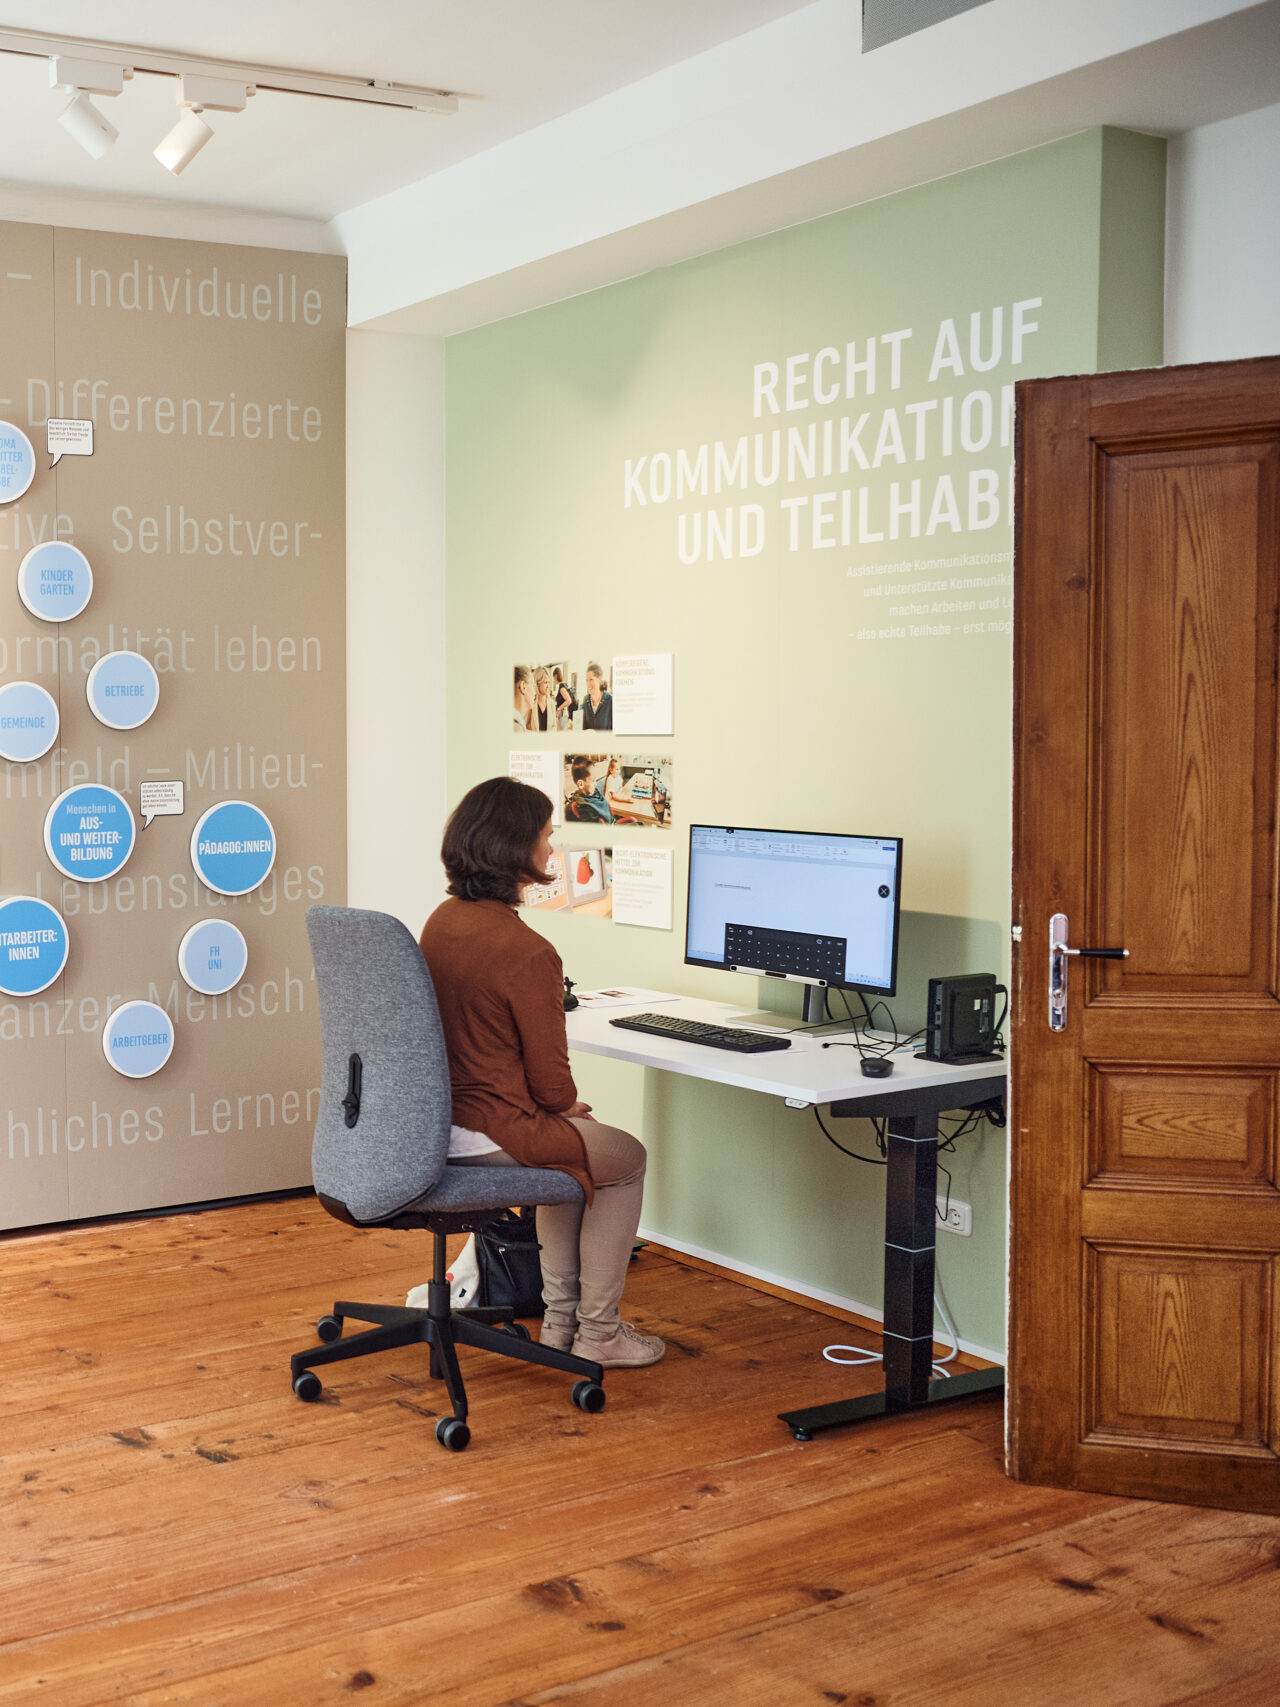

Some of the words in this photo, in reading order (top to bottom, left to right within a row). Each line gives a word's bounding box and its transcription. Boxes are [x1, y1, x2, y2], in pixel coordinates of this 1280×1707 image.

[75, 256, 322, 326] Individuelle
[753, 328, 913, 418] RECHT
[928, 296, 1043, 382] AUF
[27, 378, 321, 442] Differenzierte
[678, 503, 766, 565] UND
[781, 466, 1014, 553] TEILHAB
[112, 504, 322, 557] Selbstver-
[41, 570, 73, 582] KINDER
[846, 559, 912, 577] Assistierende
[40, 583, 75, 596] GARTEN
[863, 584, 882, 597] und
[884, 580, 947, 595] Unterstützte
[889, 602, 928, 616] machen
[930, 599, 976, 614] Arbeiten
[978, 597, 999, 610] und
[856, 627, 876, 640] also
[878, 626, 906, 639] echte
[909, 622, 951, 637] Teilhabe
[963, 621, 984, 634] erst
[987, 618, 1012, 635] mög
[213, 623, 321, 673] leben
[105, 684, 145, 698] BETRIEBE
[0, 716, 46, 729] GEMEINDE
[185, 745, 324, 792] Milieu-
[66, 803, 106, 815] Menschen
[108, 802, 116, 814] in
[80, 816, 104, 831] AUS-
[60, 832, 81, 847] UND
[83, 831, 123, 846] WEITER-
[198, 836, 272, 856] PÄDAGOG:INNEN
[71, 846, 113, 863] BILDUNG
[8, 945, 40, 961] INNEN
[209, 946, 220, 958] FH
[208, 958, 222, 970] UNI
[112, 1032, 168, 1050] ARBEITGEBER
